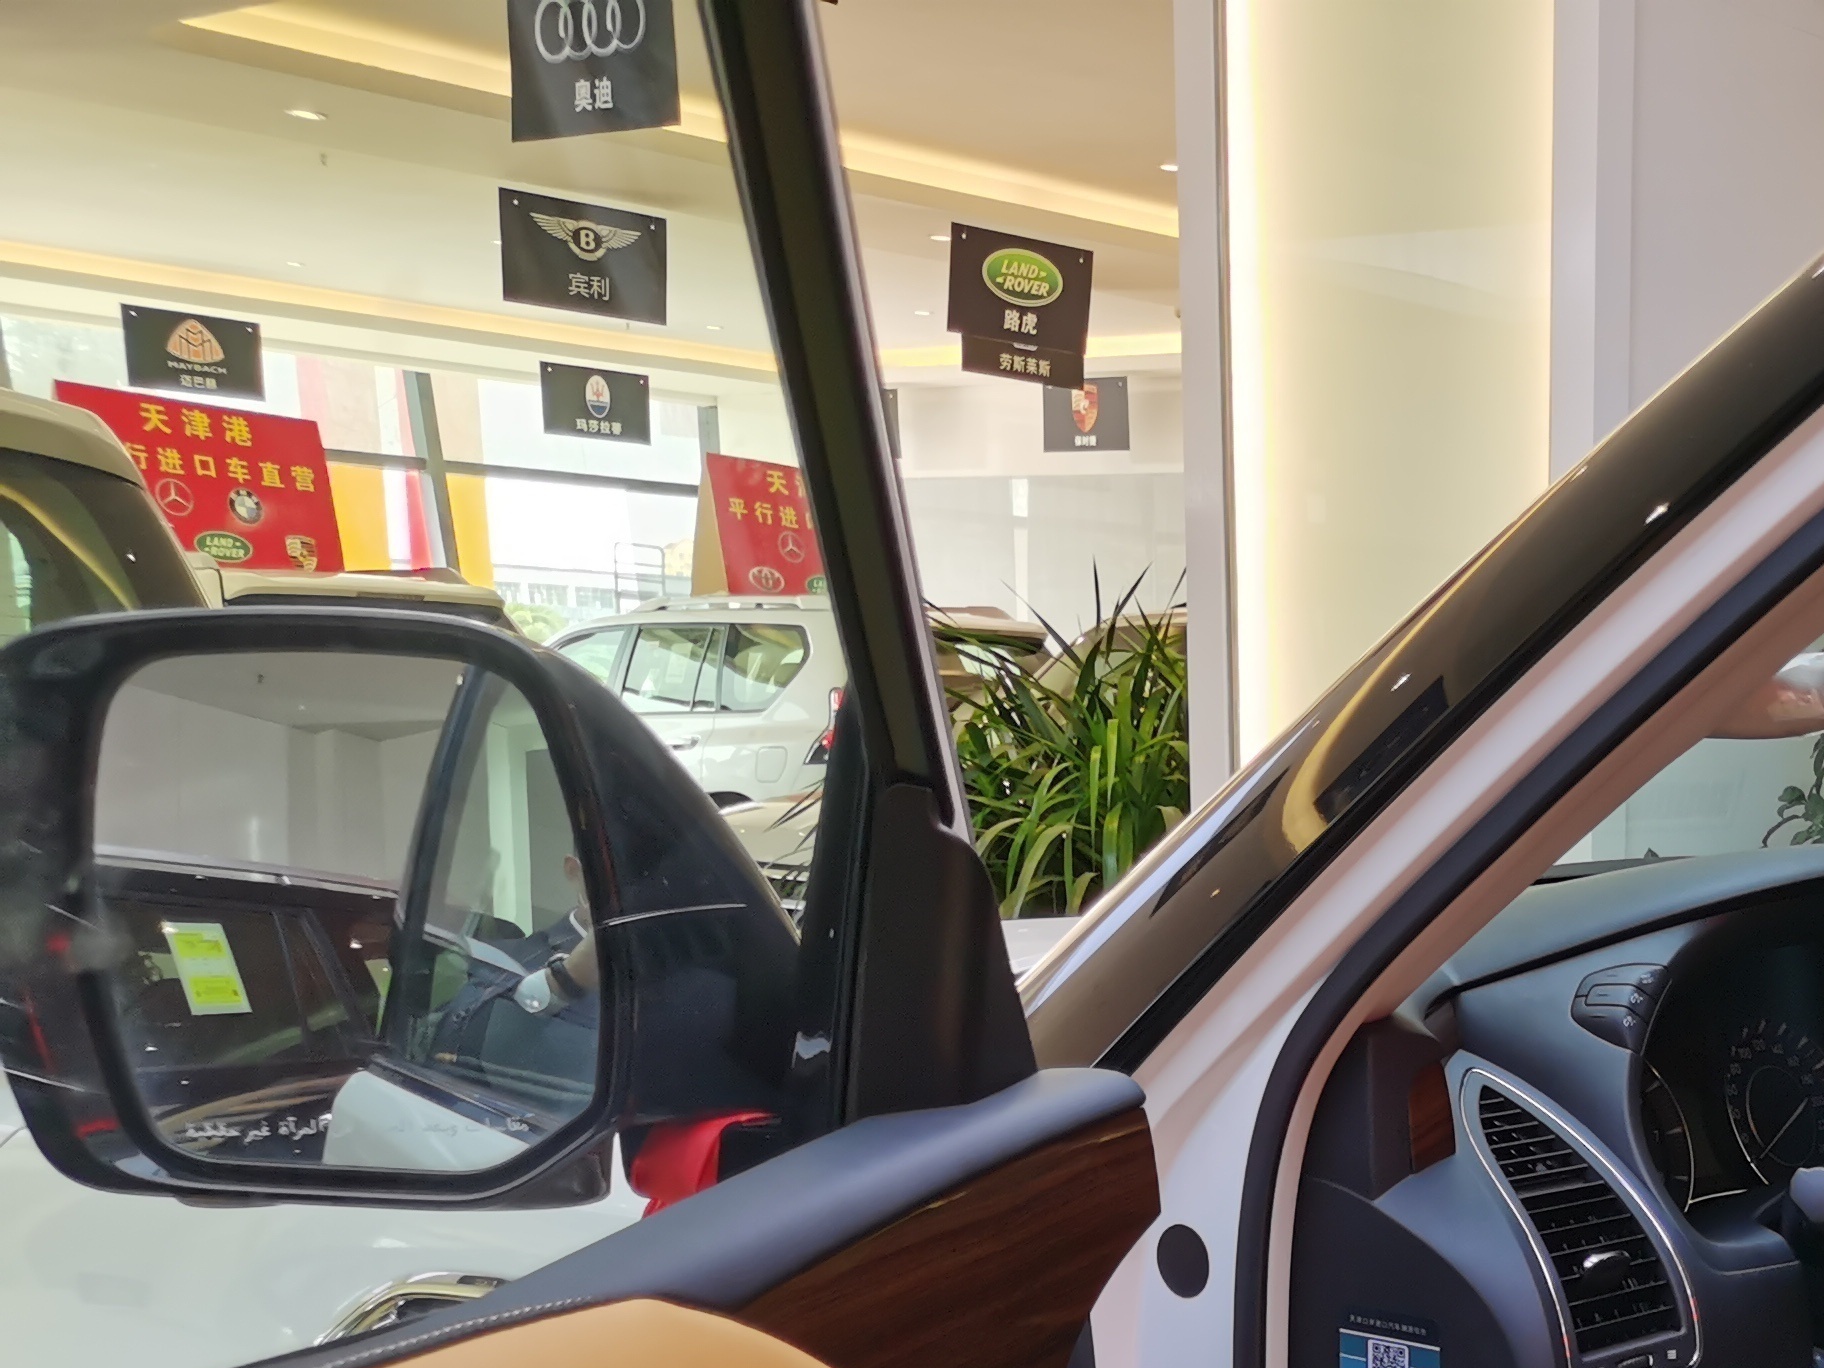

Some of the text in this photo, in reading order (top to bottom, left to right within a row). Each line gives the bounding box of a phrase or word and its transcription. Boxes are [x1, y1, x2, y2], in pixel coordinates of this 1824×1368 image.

[573, 76, 614, 112] 奥迪
[1001, 259, 1038, 279] LAND
[568, 272, 611, 302] 宾利
[1003, 276, 1050, 297] ROVER
[1003, 309, 1038, 335] 路虎
[166, 360, 227, 374] MAYBACH
[1000, 353, 1051, 377] 劳斯莱斯
[139, 402, 253, 446] 天津港
